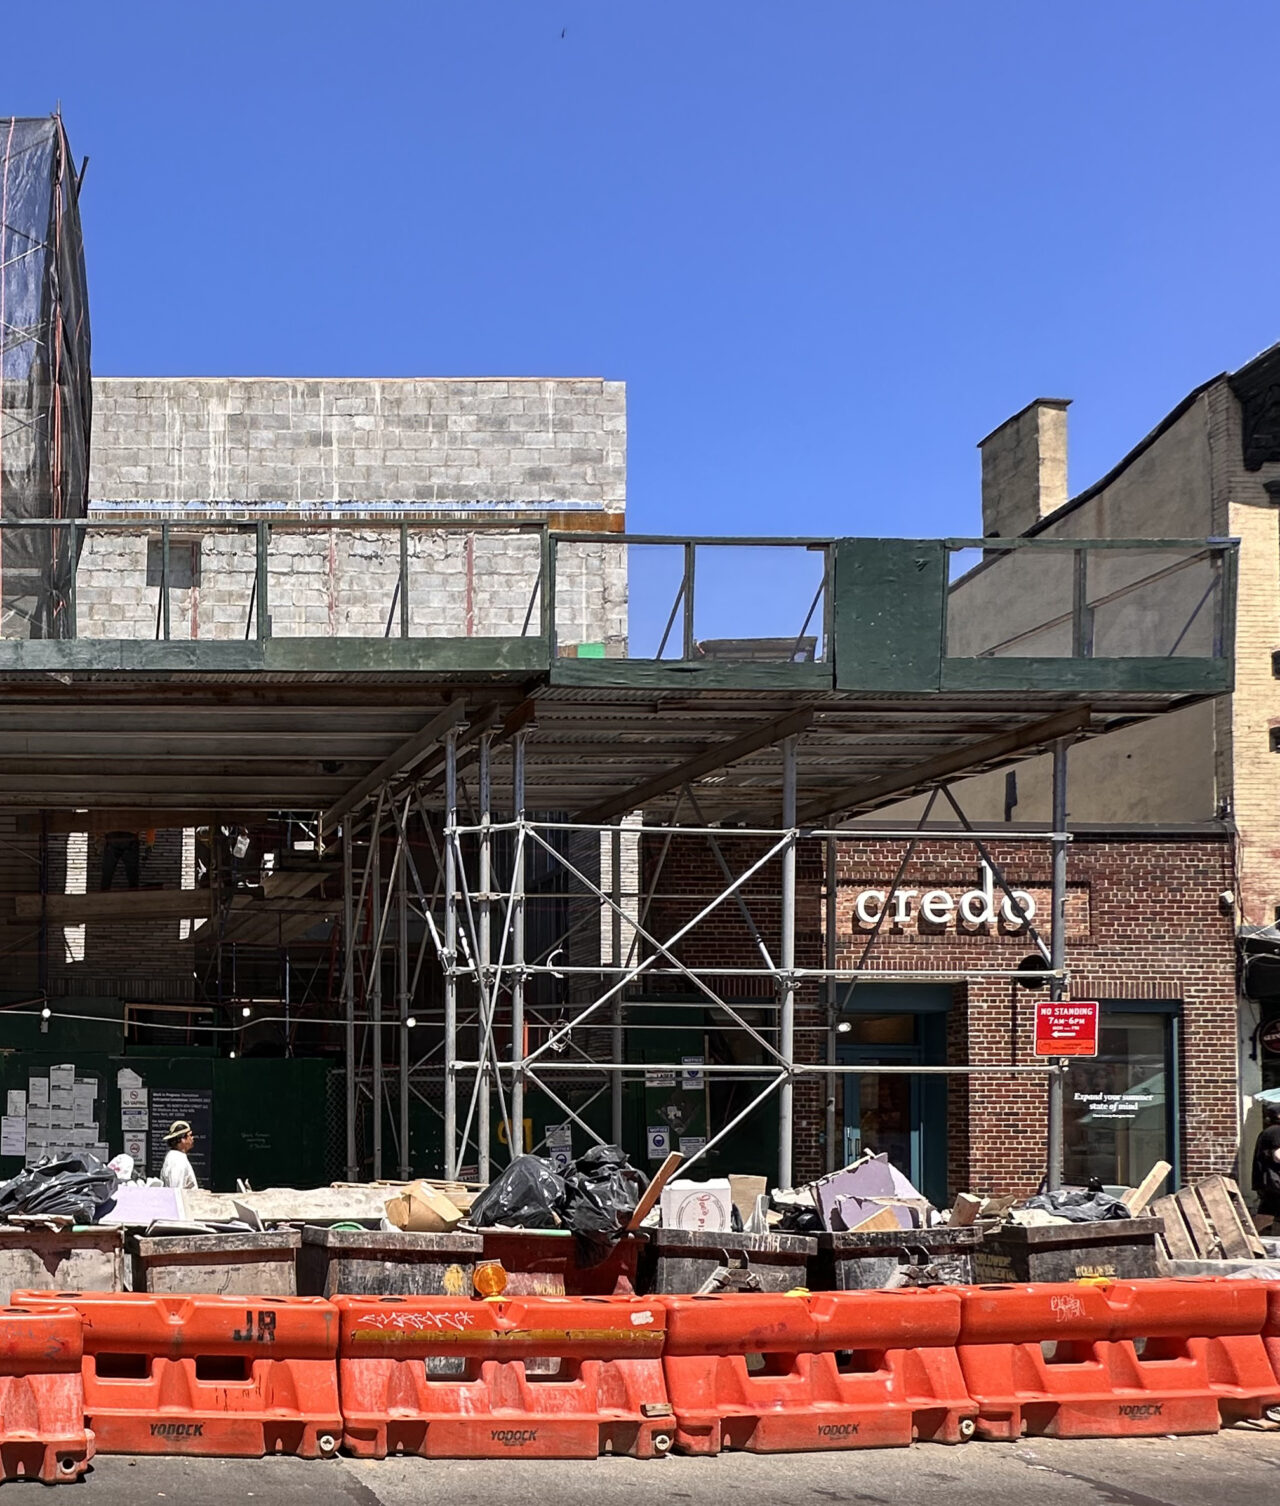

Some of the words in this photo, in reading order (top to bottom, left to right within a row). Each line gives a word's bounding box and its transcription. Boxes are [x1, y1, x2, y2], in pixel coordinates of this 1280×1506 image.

[855, 859, 1036, 924] credo
[1048, 1017, 1086, 1025] 7AM-6PM
[1074, 1092, 1103, 1102] Expand
[1089, 1102, 1108, 1110] state
[1109, 1102, 1119, 1112] of
[1118, 1102, 1138, 1110] mind
[233, 1311, 276, 1342] JR
[1119, 1403, 1163, 1416] YODOCK
[150, 1423, 204, 1436] YODOCK
[491, 1429, 538, 1441] YODOCK
[818, 1422, 860, 1435] YODOCK
